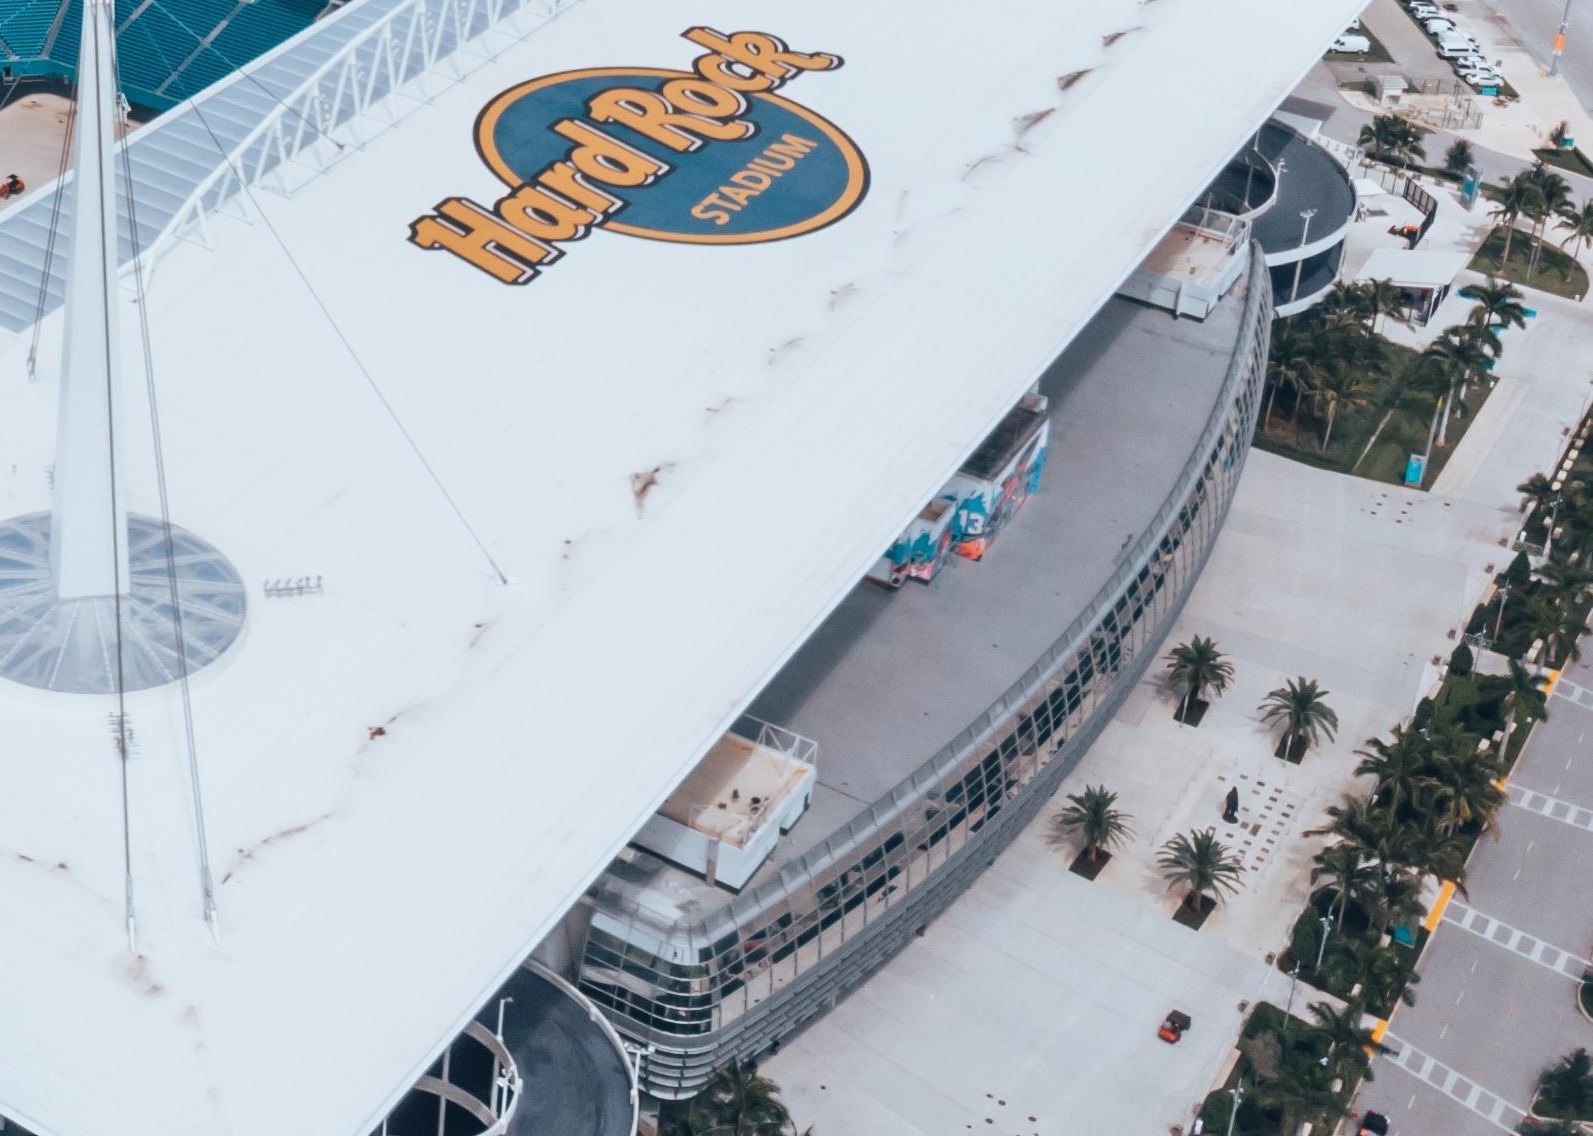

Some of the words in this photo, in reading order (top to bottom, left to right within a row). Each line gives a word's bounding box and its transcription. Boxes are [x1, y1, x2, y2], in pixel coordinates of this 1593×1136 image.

[406, 118, 675, 285] Hard
[585, 26, 845, 153] Rock
[691, 133, 818, 225] STADIUM
[958, 510, 984, 534] 13
